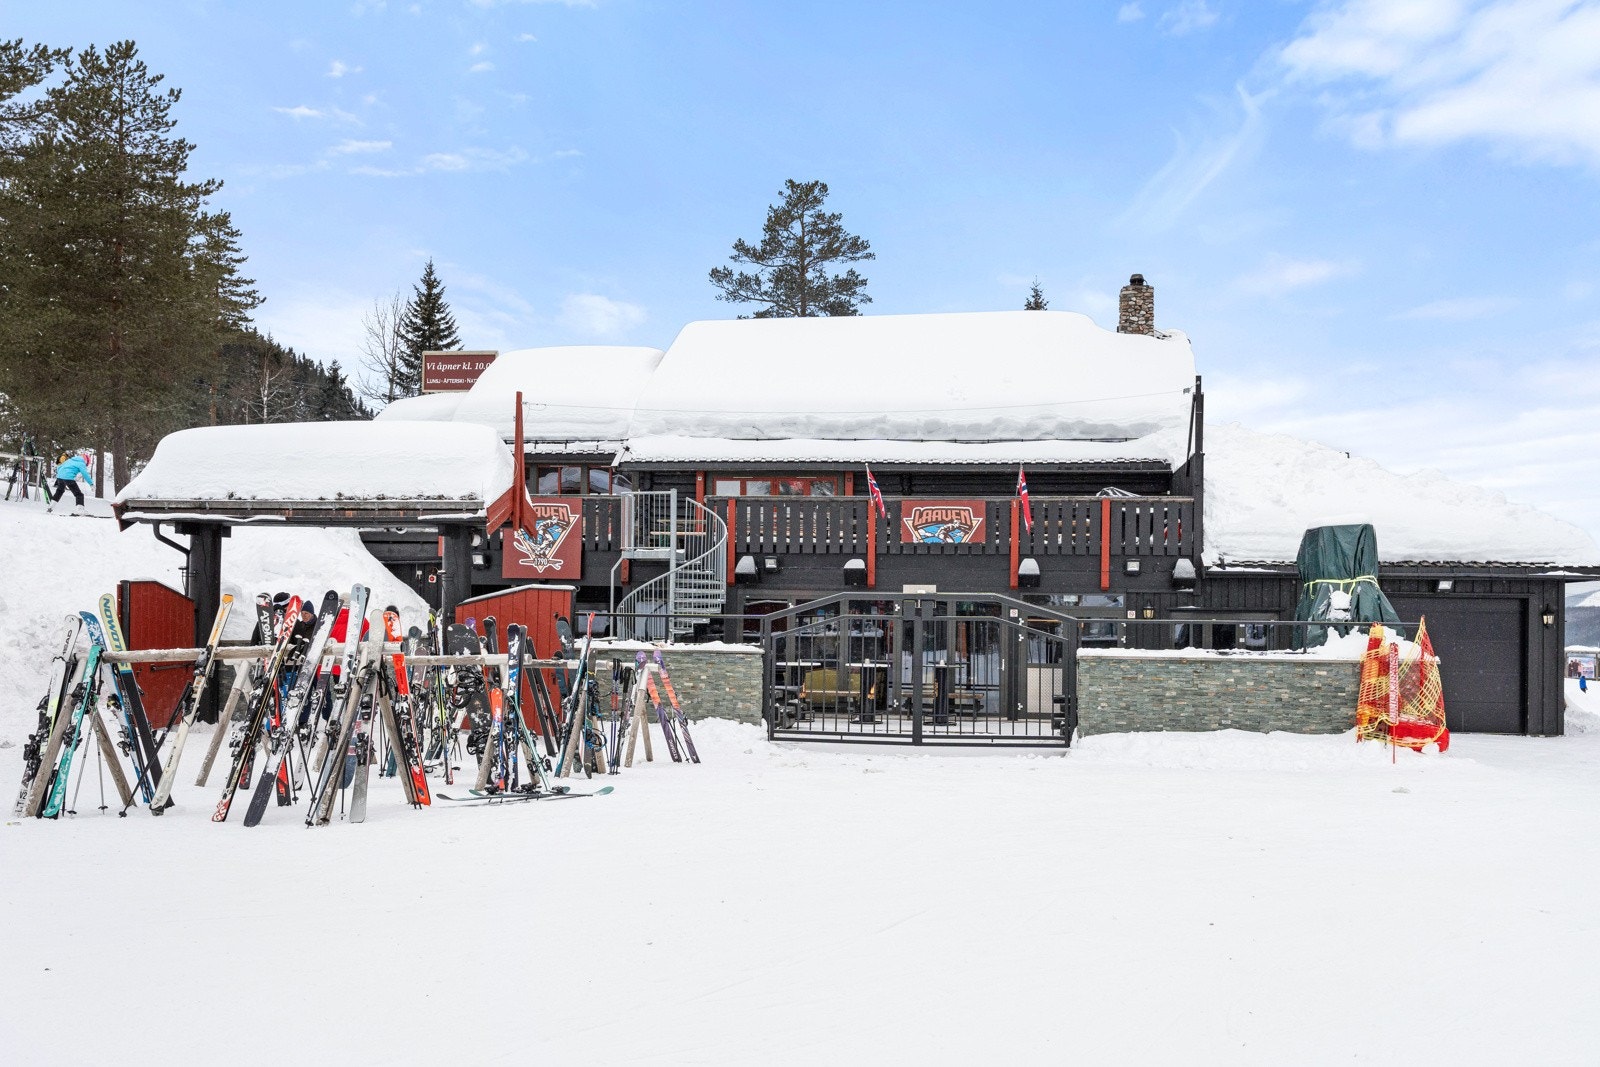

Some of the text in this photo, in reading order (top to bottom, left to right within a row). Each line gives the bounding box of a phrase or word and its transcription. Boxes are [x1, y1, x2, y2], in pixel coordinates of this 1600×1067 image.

[427, 361, 490, 372] Vi åpner kl. 10.0
[533, 506, 568, 521] AVEN
[914, 509, 971, 526] LAAVEN
[259, 609, 273, 645] ATOMI
